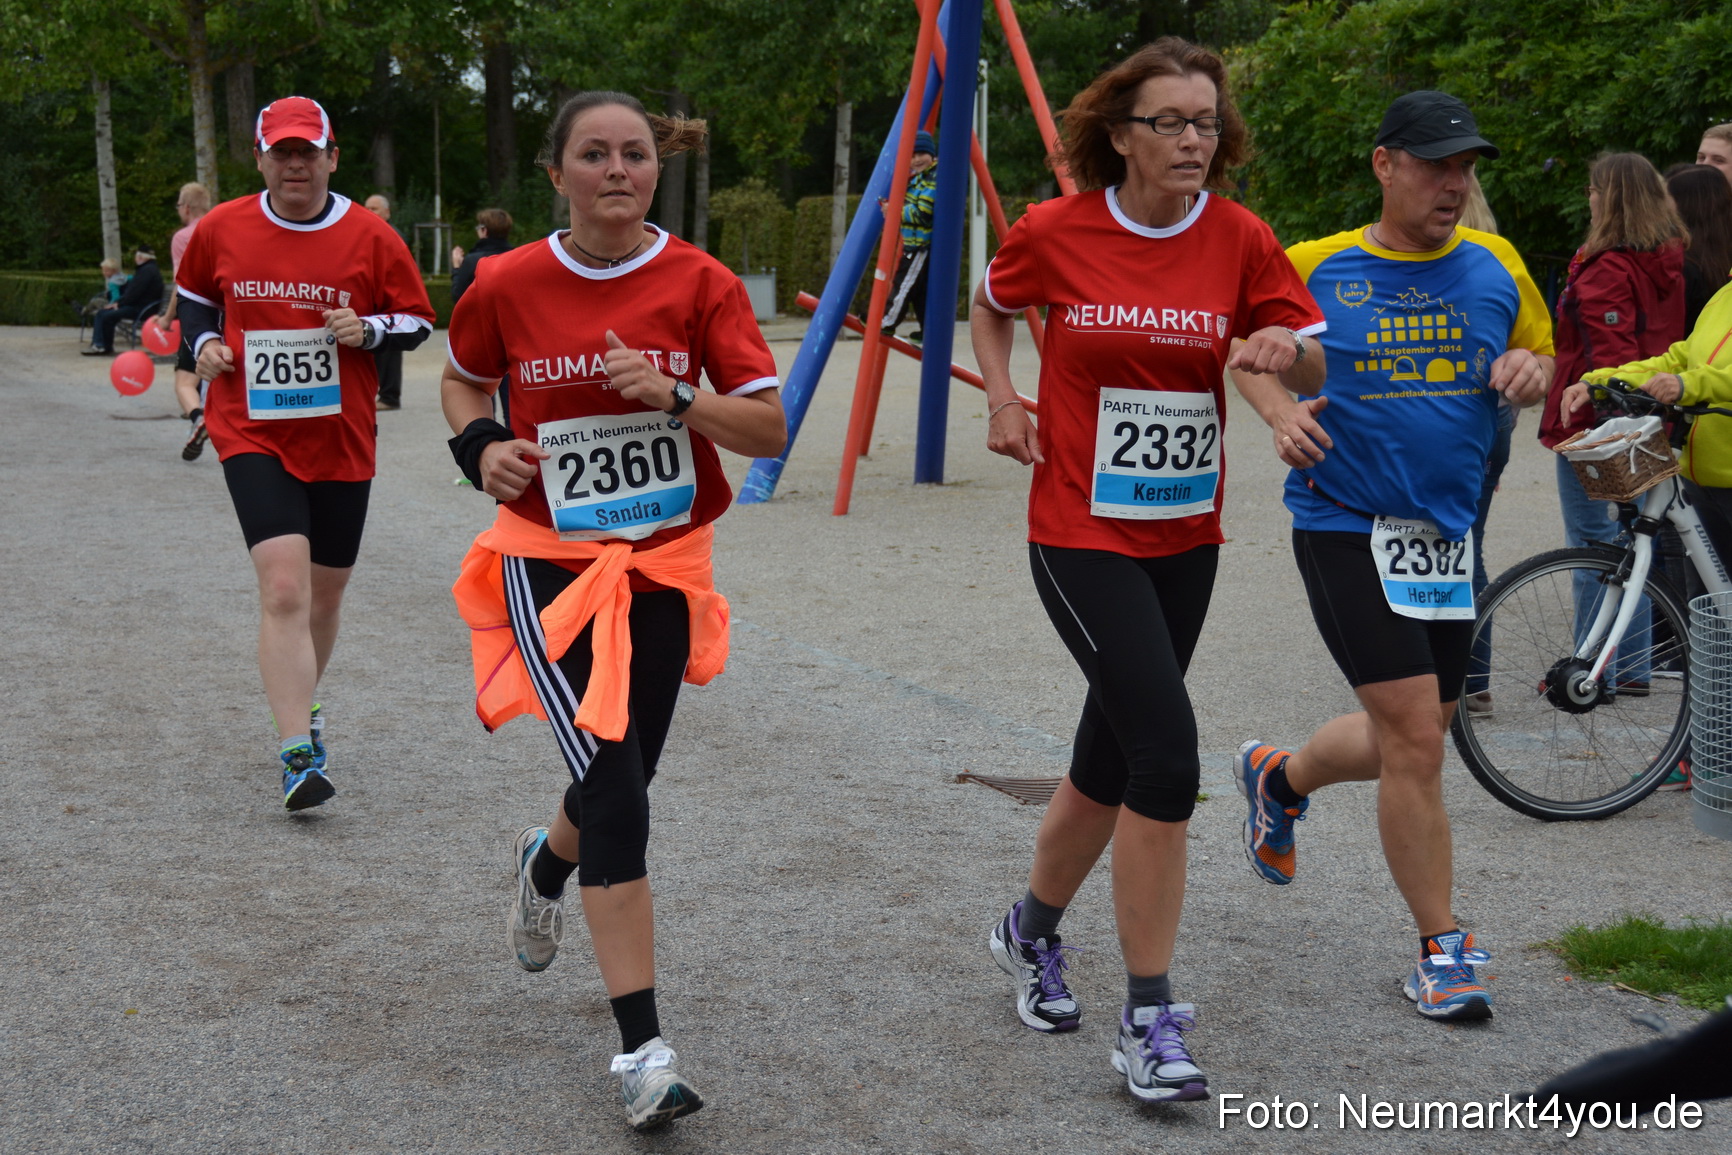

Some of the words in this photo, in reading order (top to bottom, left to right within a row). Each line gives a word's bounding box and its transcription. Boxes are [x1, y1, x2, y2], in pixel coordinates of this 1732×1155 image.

[233, 281, 336, 302] NEUMARKT
[1343, 290, 1365, 298] Jahre
[1065, 305, 1212, 333] NEUMARKT
[247, 339, 274, 348] PARTL
[276, 338, 323, 348] Neumarkt
[1150, 336, 1186, 346] STARKE
[1188, 339, 1212, 349] STADT
[1369, 347, 1436, 357] 21.September
[1438, 345, 1462, 353] 2014
[254, 350, 333, 385] 2653
[519, 350, 662, 384] NEUMAT
[274, 393, 314, 406] Dieter
[1103, 400, 1151, 416] PARTL
[1154, 404, 1214, 418] Neumarkt
[541, 431, 590, 449] PARTL
[592, 422, 662, 441] Neumarkt
[1111, 421, 1217, 470] 2332
[558, 436, 680, 501] 2360
[1133, 482, 1191, 501] Kerstin
[595, 501, 662, 526] Sandra
[1376, 522, 1416, 535] PARTL
[1385, 537, 1467, 576] 2382
[1407, 587, 1454, 603] Herbert
